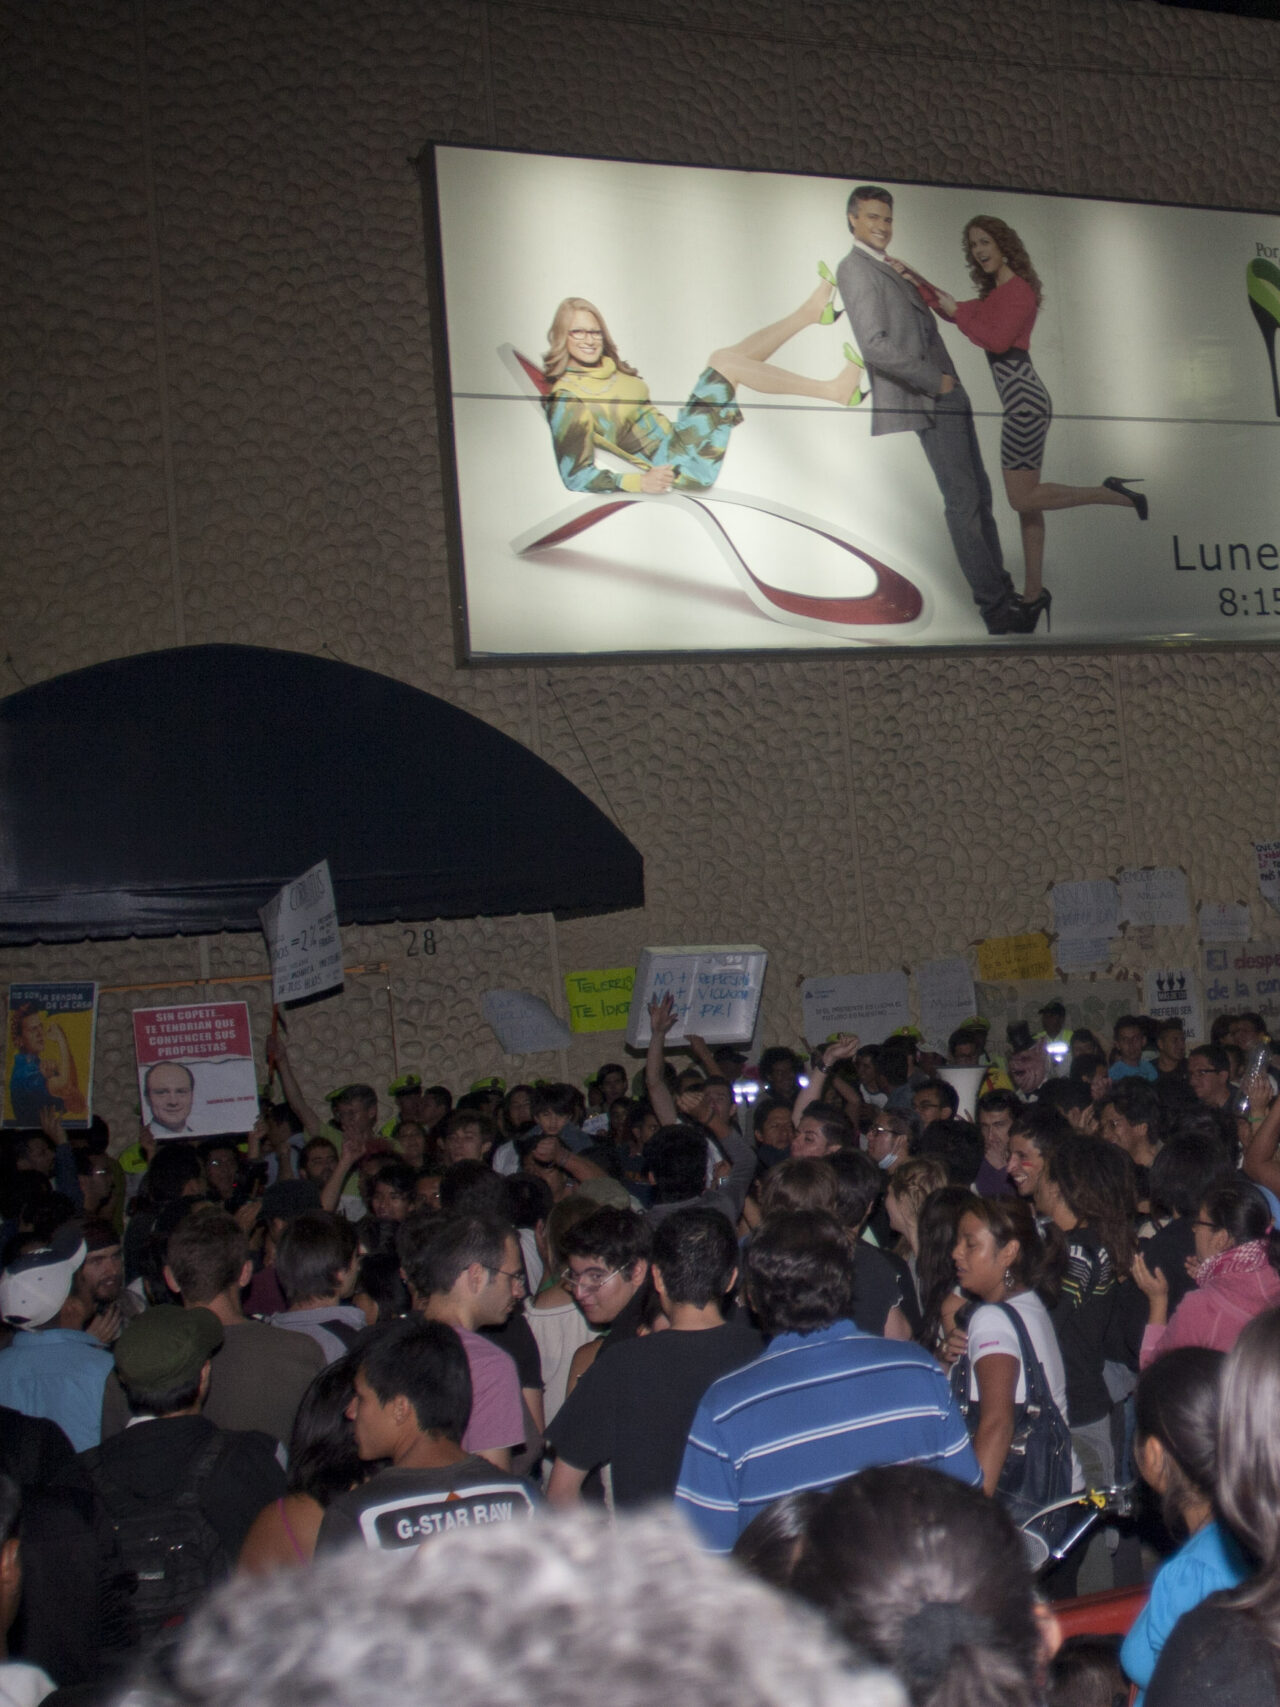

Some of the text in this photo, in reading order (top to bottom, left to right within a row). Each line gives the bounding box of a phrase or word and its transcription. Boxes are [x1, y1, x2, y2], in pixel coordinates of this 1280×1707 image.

[1255, 242, 1279, 258] Por
[403, 929, 436, 957] 28
[1207, 949, 1228, 971] El
[654, 972, 674, 986] NO
[1207, 978, 1229, 1001] de
[1235, 979, 1249, 997] la
[45, 1001, 57, 1010] DE
[572, 1004, 597, 1018] TE
[700, 1003, 732, 1017] PRI
[156, 1012, 175, 1022] SIN
[145, 1025, 157, 1035] TE
[214, 1018, 235, 1029] QUE
[149, 1030, 236, 1046] CONVENCER SUS
[157, 1042, 227, 1057] PROPUESTAS
[397, 1502, 513, 1540] G-STAR RAW
